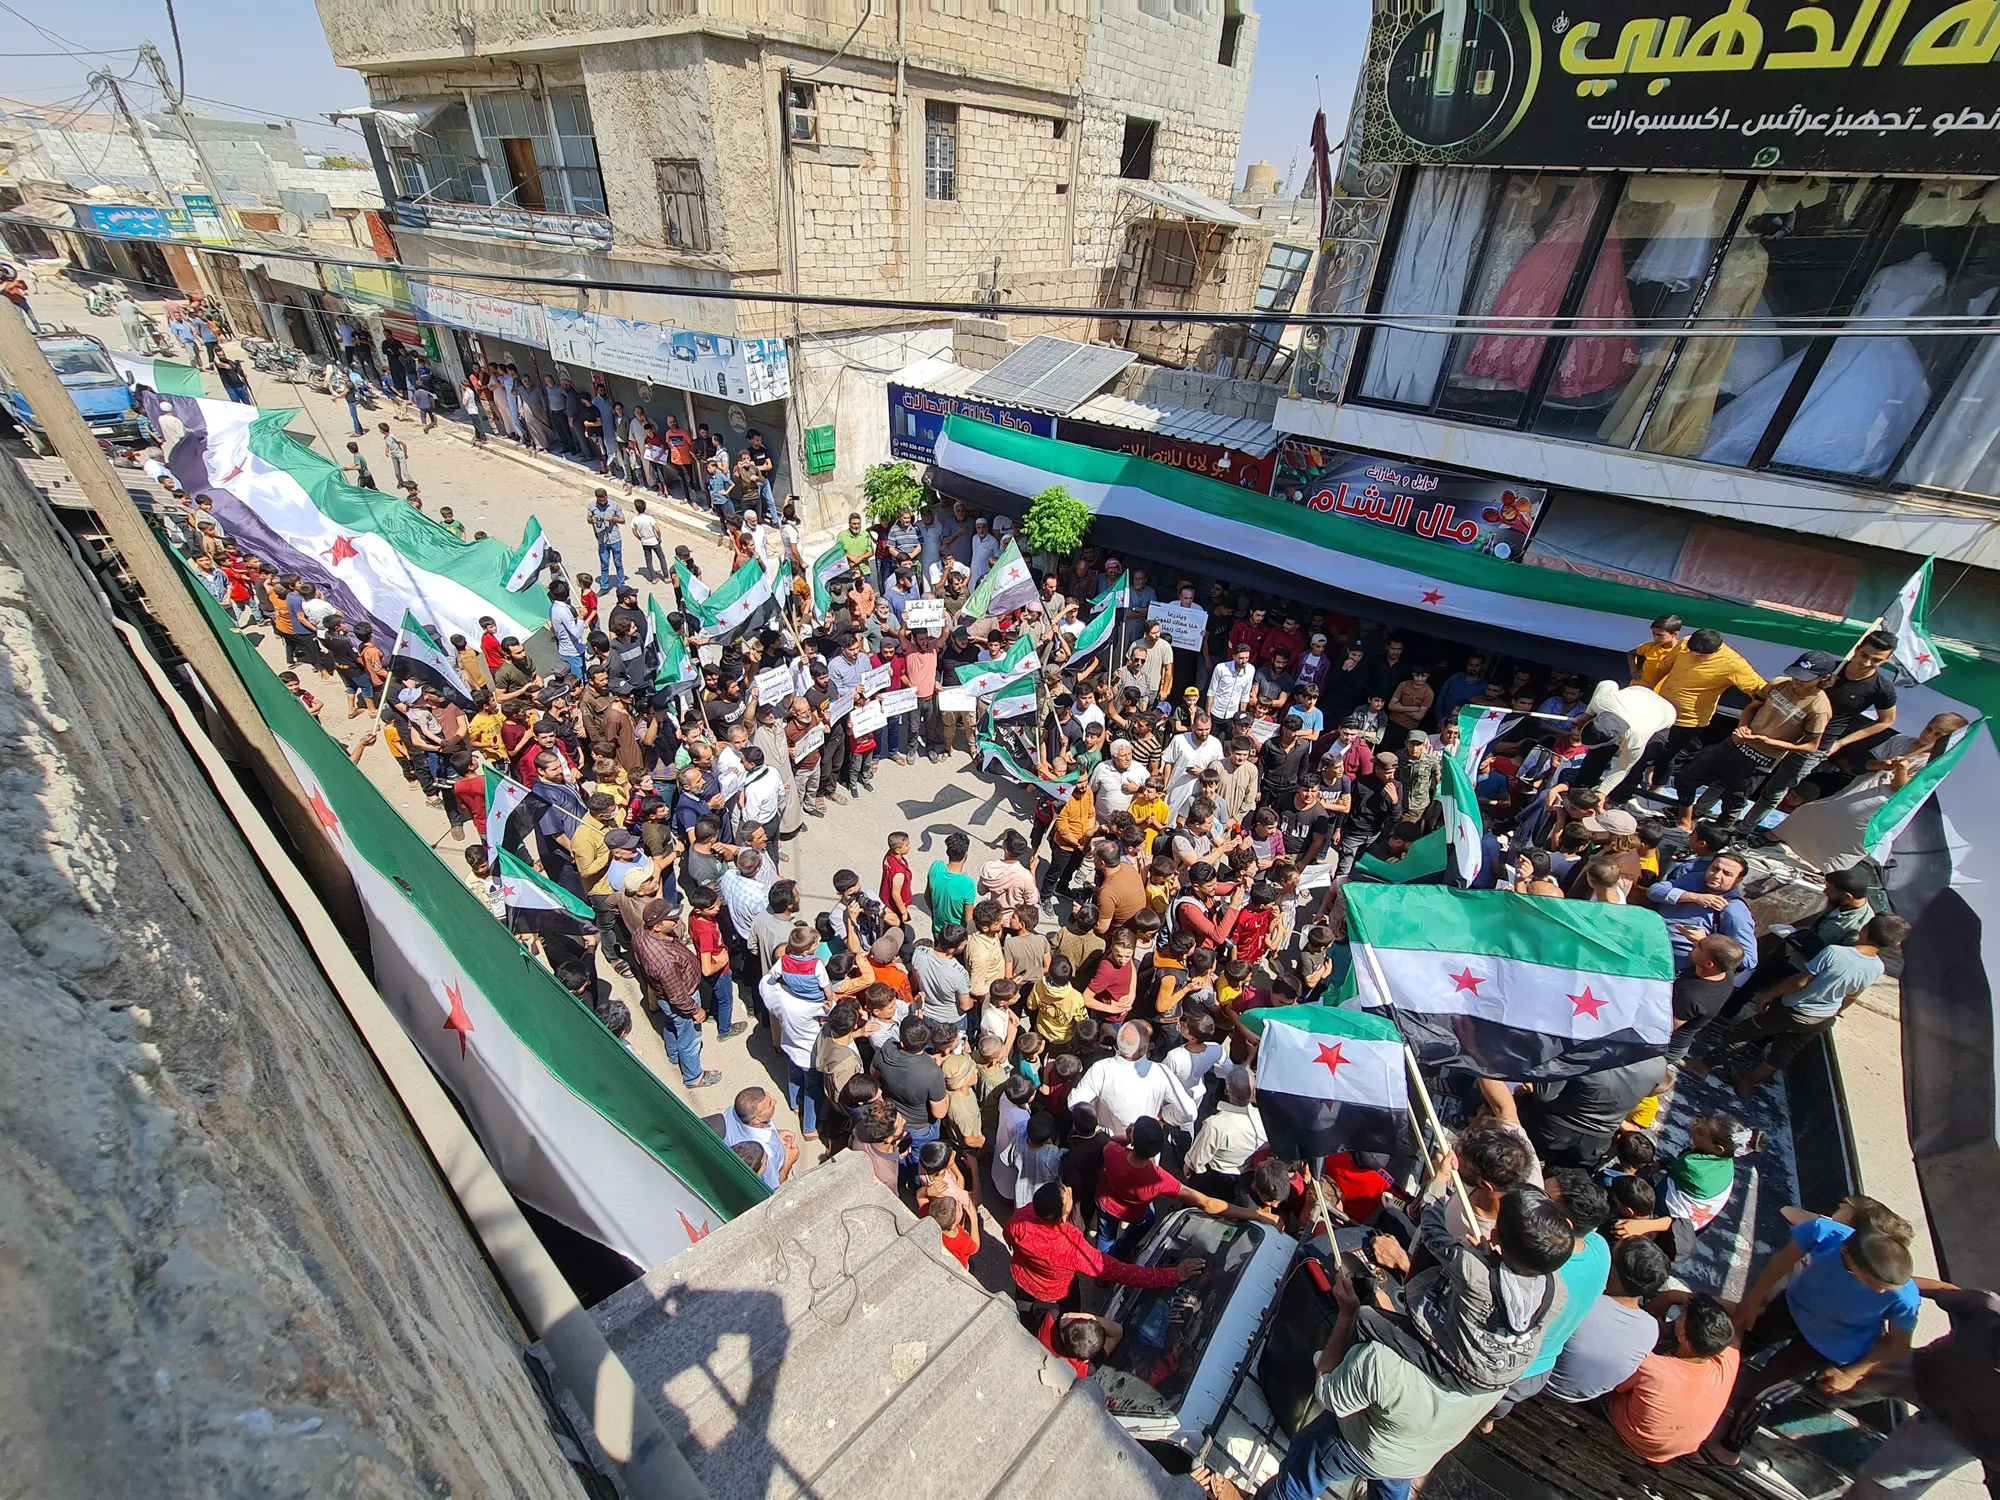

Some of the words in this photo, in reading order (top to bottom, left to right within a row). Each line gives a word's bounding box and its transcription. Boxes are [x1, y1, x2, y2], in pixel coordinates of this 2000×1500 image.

[1587, 106, 1731, 136] اكسسوارات
[1741, 103, 1831, 137] عرائس
[1824, 105, 1923, 137] تجهيز
[1365, 465, 1400, 486] بهارات
[1402, 476, 1410, 488] و
[1307, 483, 1415, 527] الشام
[1415, 503, 1479, 544] مال
[908, 601, 924, 612] لكل
